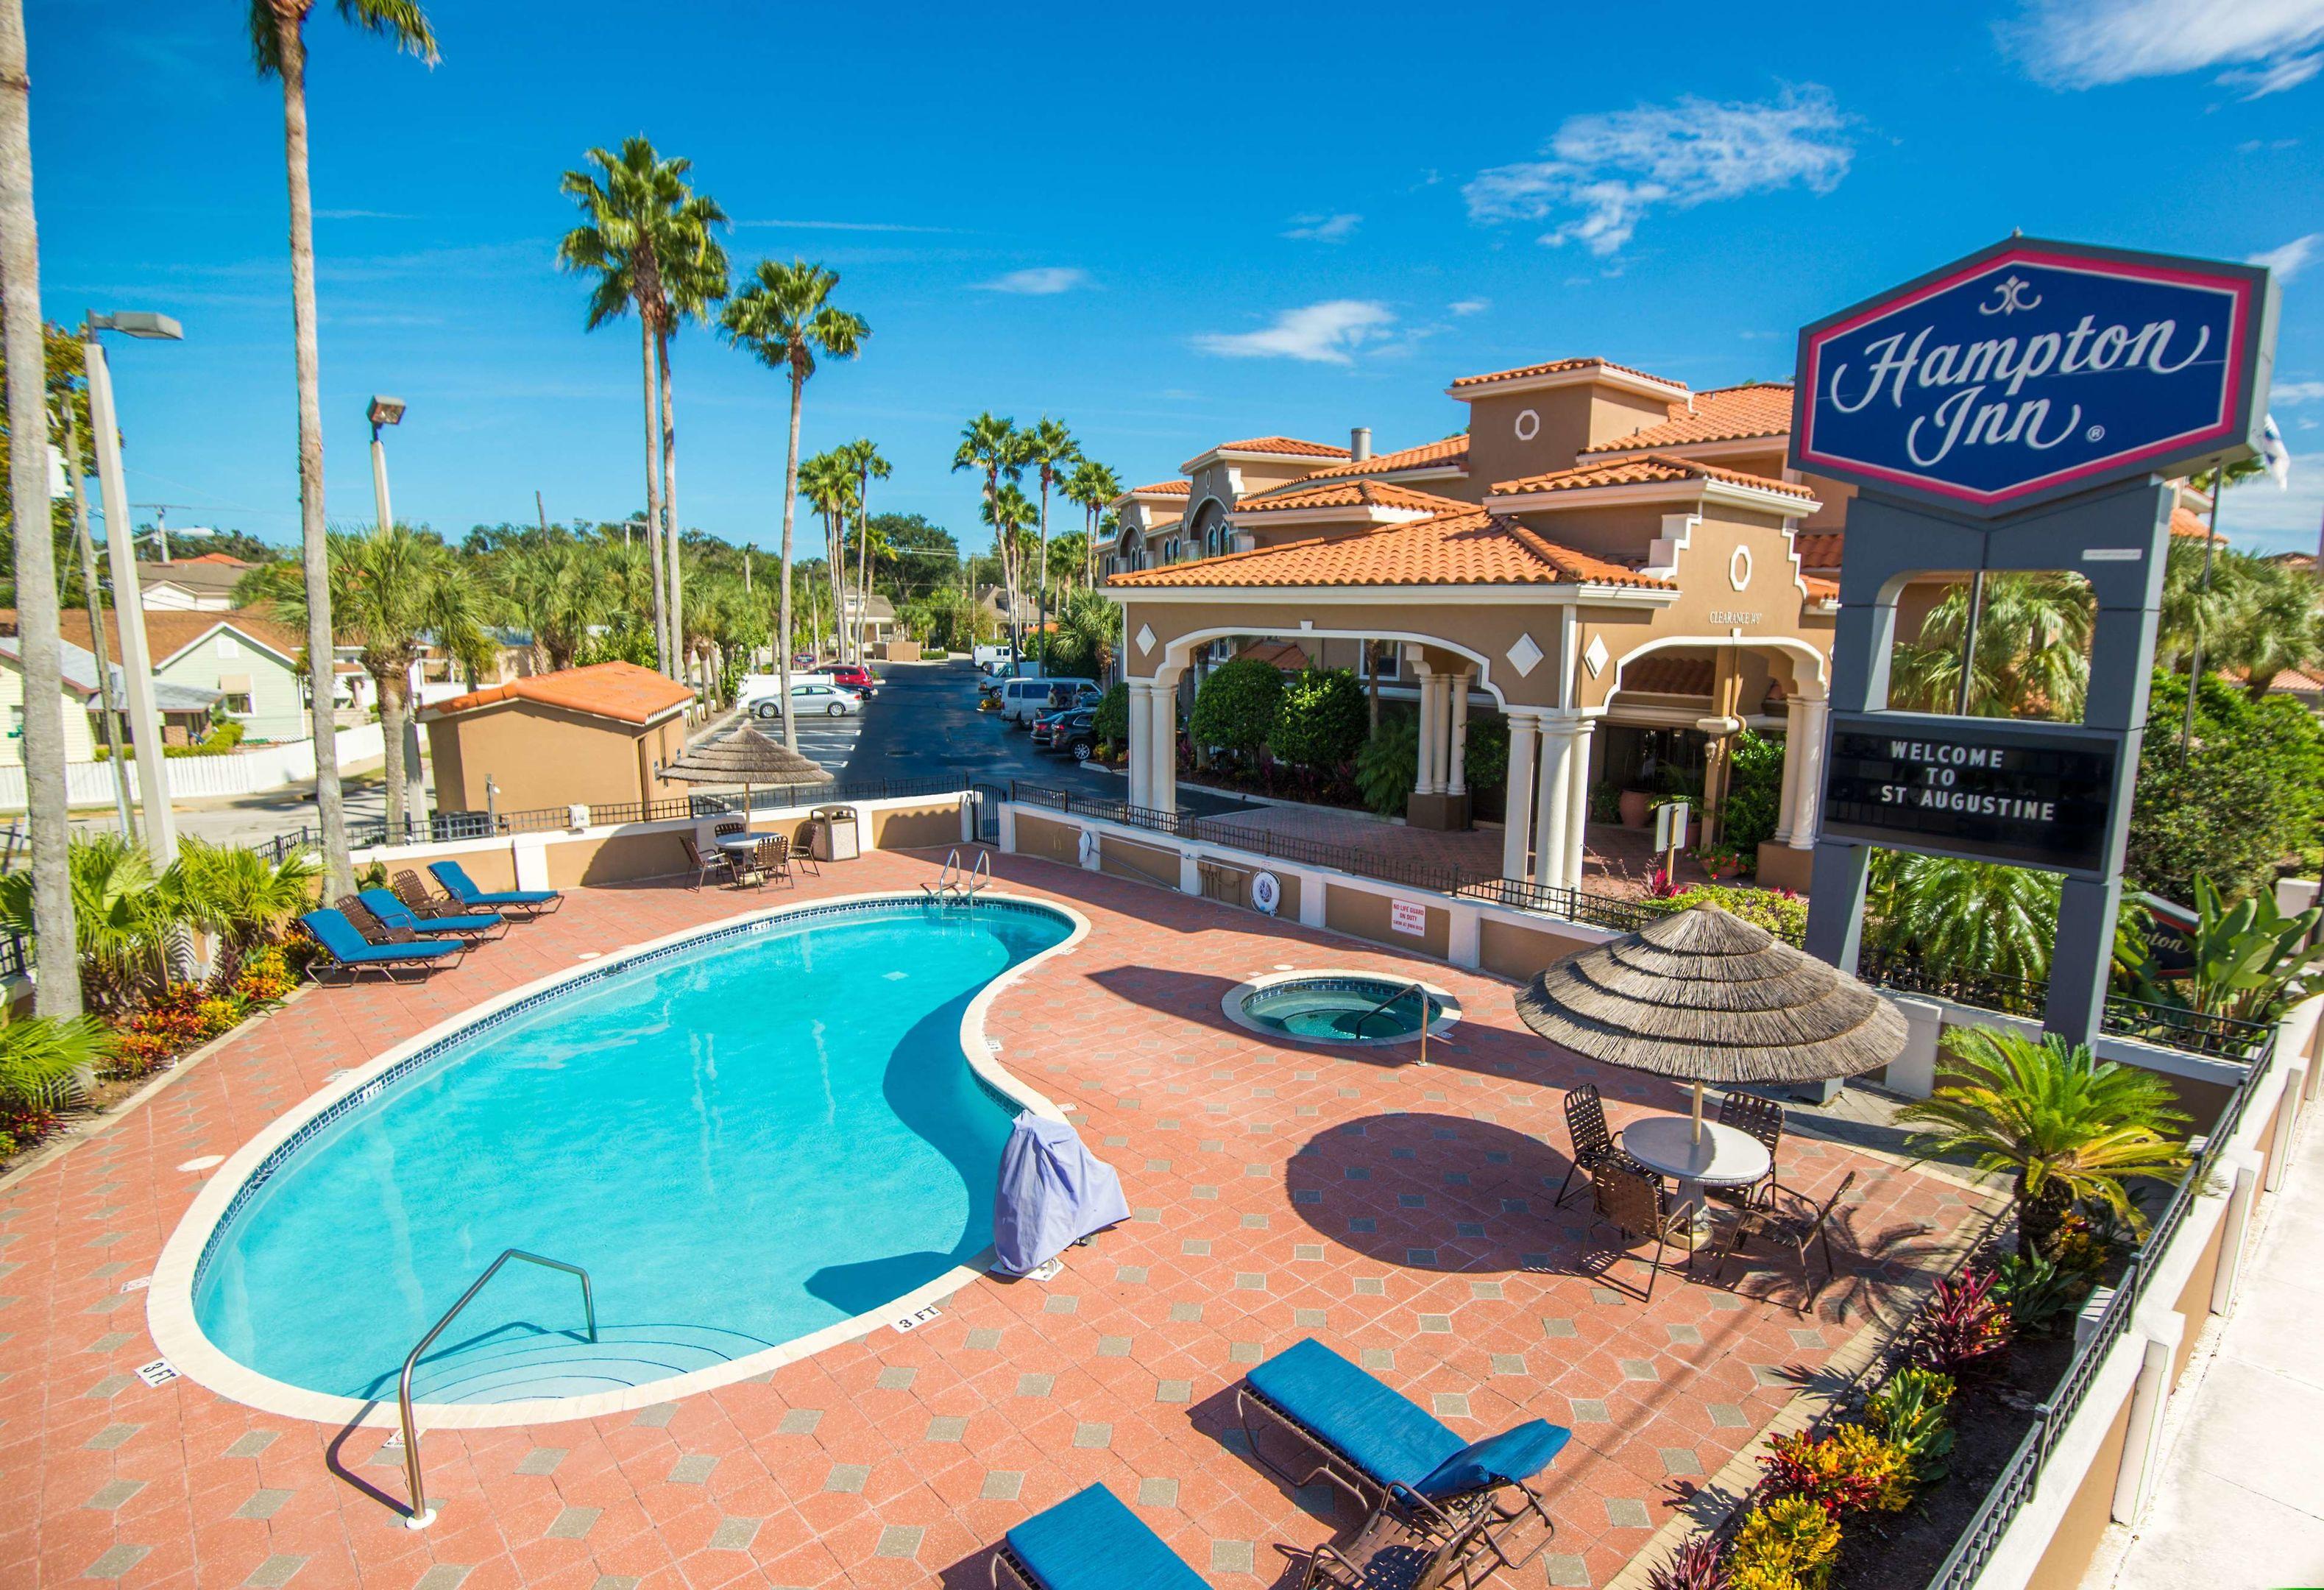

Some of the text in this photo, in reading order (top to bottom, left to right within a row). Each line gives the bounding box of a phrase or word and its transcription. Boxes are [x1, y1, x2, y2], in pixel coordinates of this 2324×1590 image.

[1831, 314, 2210, 414] Hampton
[1907, 386, 2081, 467] Inn
[1710, 611, 1749, 624] CLEARANCE
[1891, 741, 2004, 768] WELCOME
[1927, 767, 1956, 786] TO
[1881, 785, 2055, 822] ST AUGUSTINE
[1400, 905, 1409, 913] LIFE
[1410, 907, 1424, 916] GUARD
[1406, 914, 1417, 922] DUTY
[899, 1318, 913, 1328] 3
[143, 1362, 164, 1373] 3
